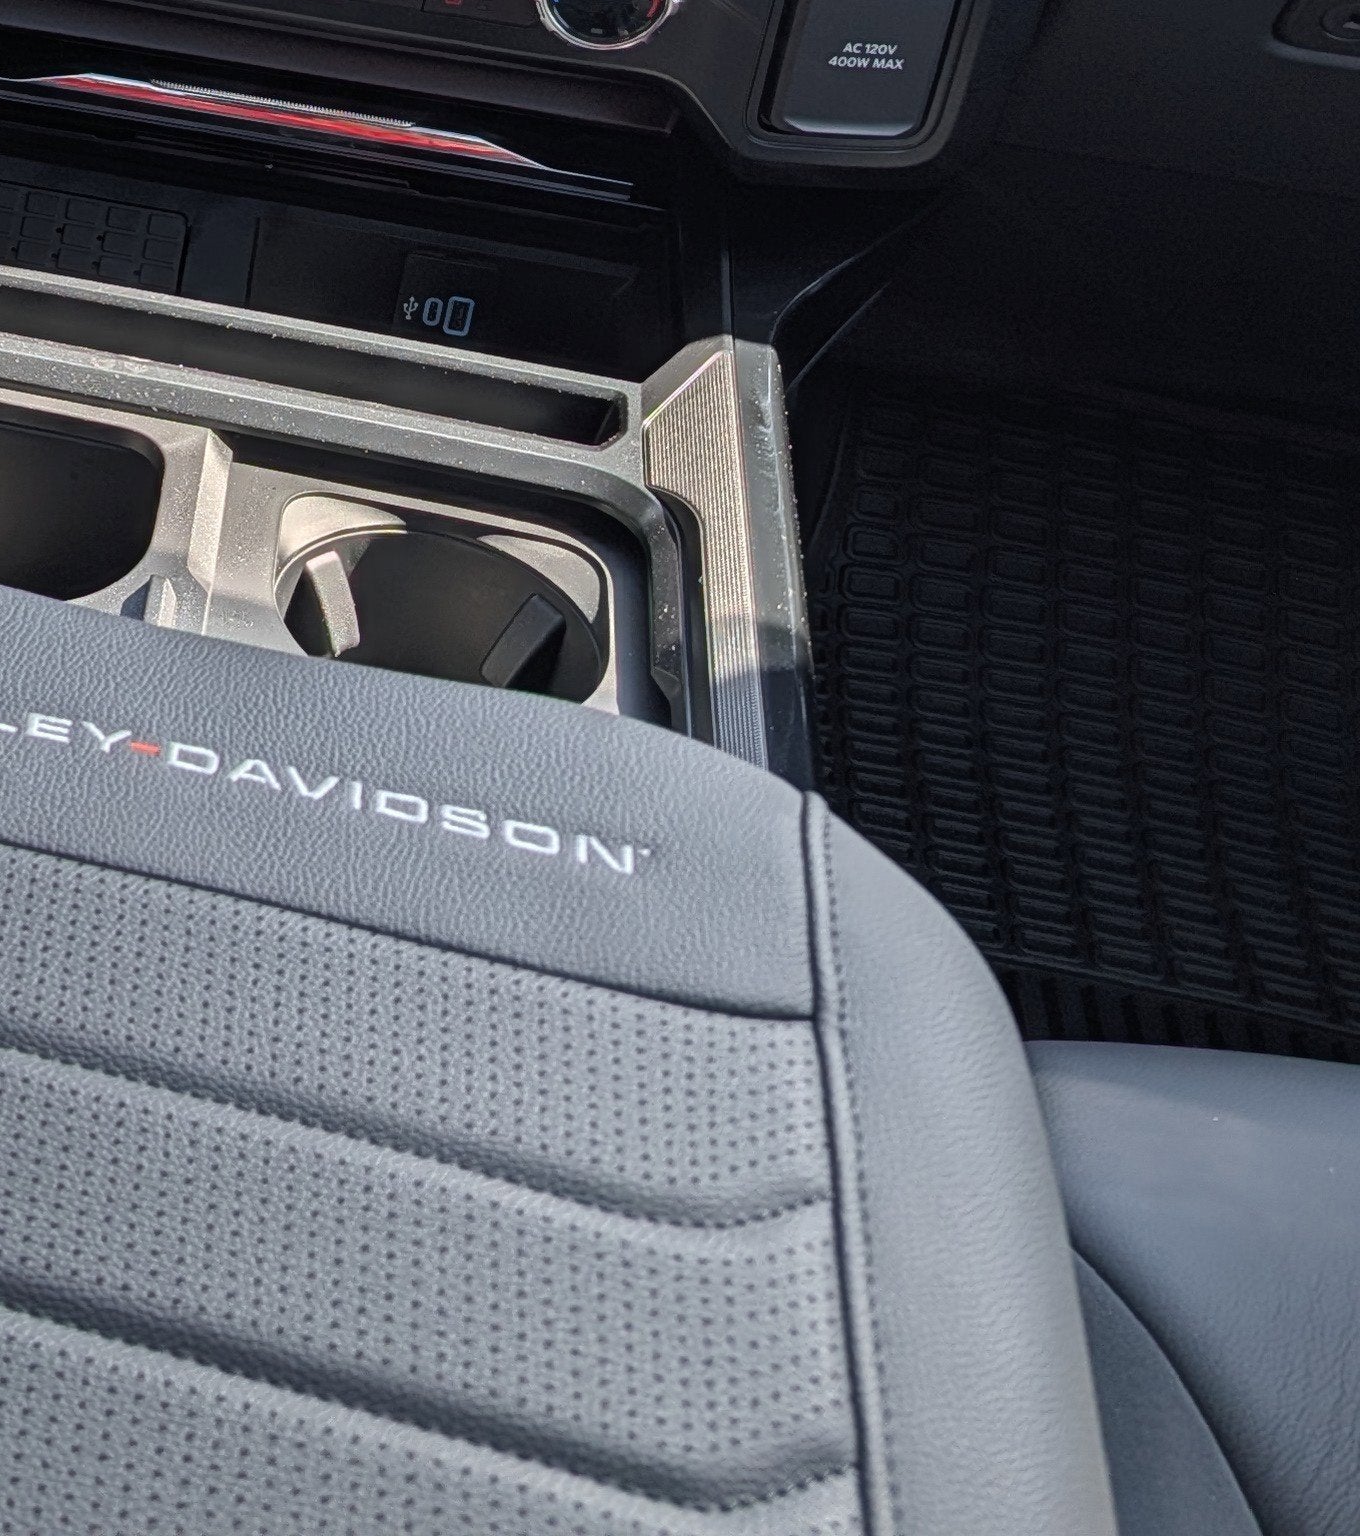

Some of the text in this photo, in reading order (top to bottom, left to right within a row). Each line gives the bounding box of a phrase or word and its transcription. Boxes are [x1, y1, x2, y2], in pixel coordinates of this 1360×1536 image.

[842, 42, 898, 55] AC 120V
[828, 55, 905, 70] 400W MAX
